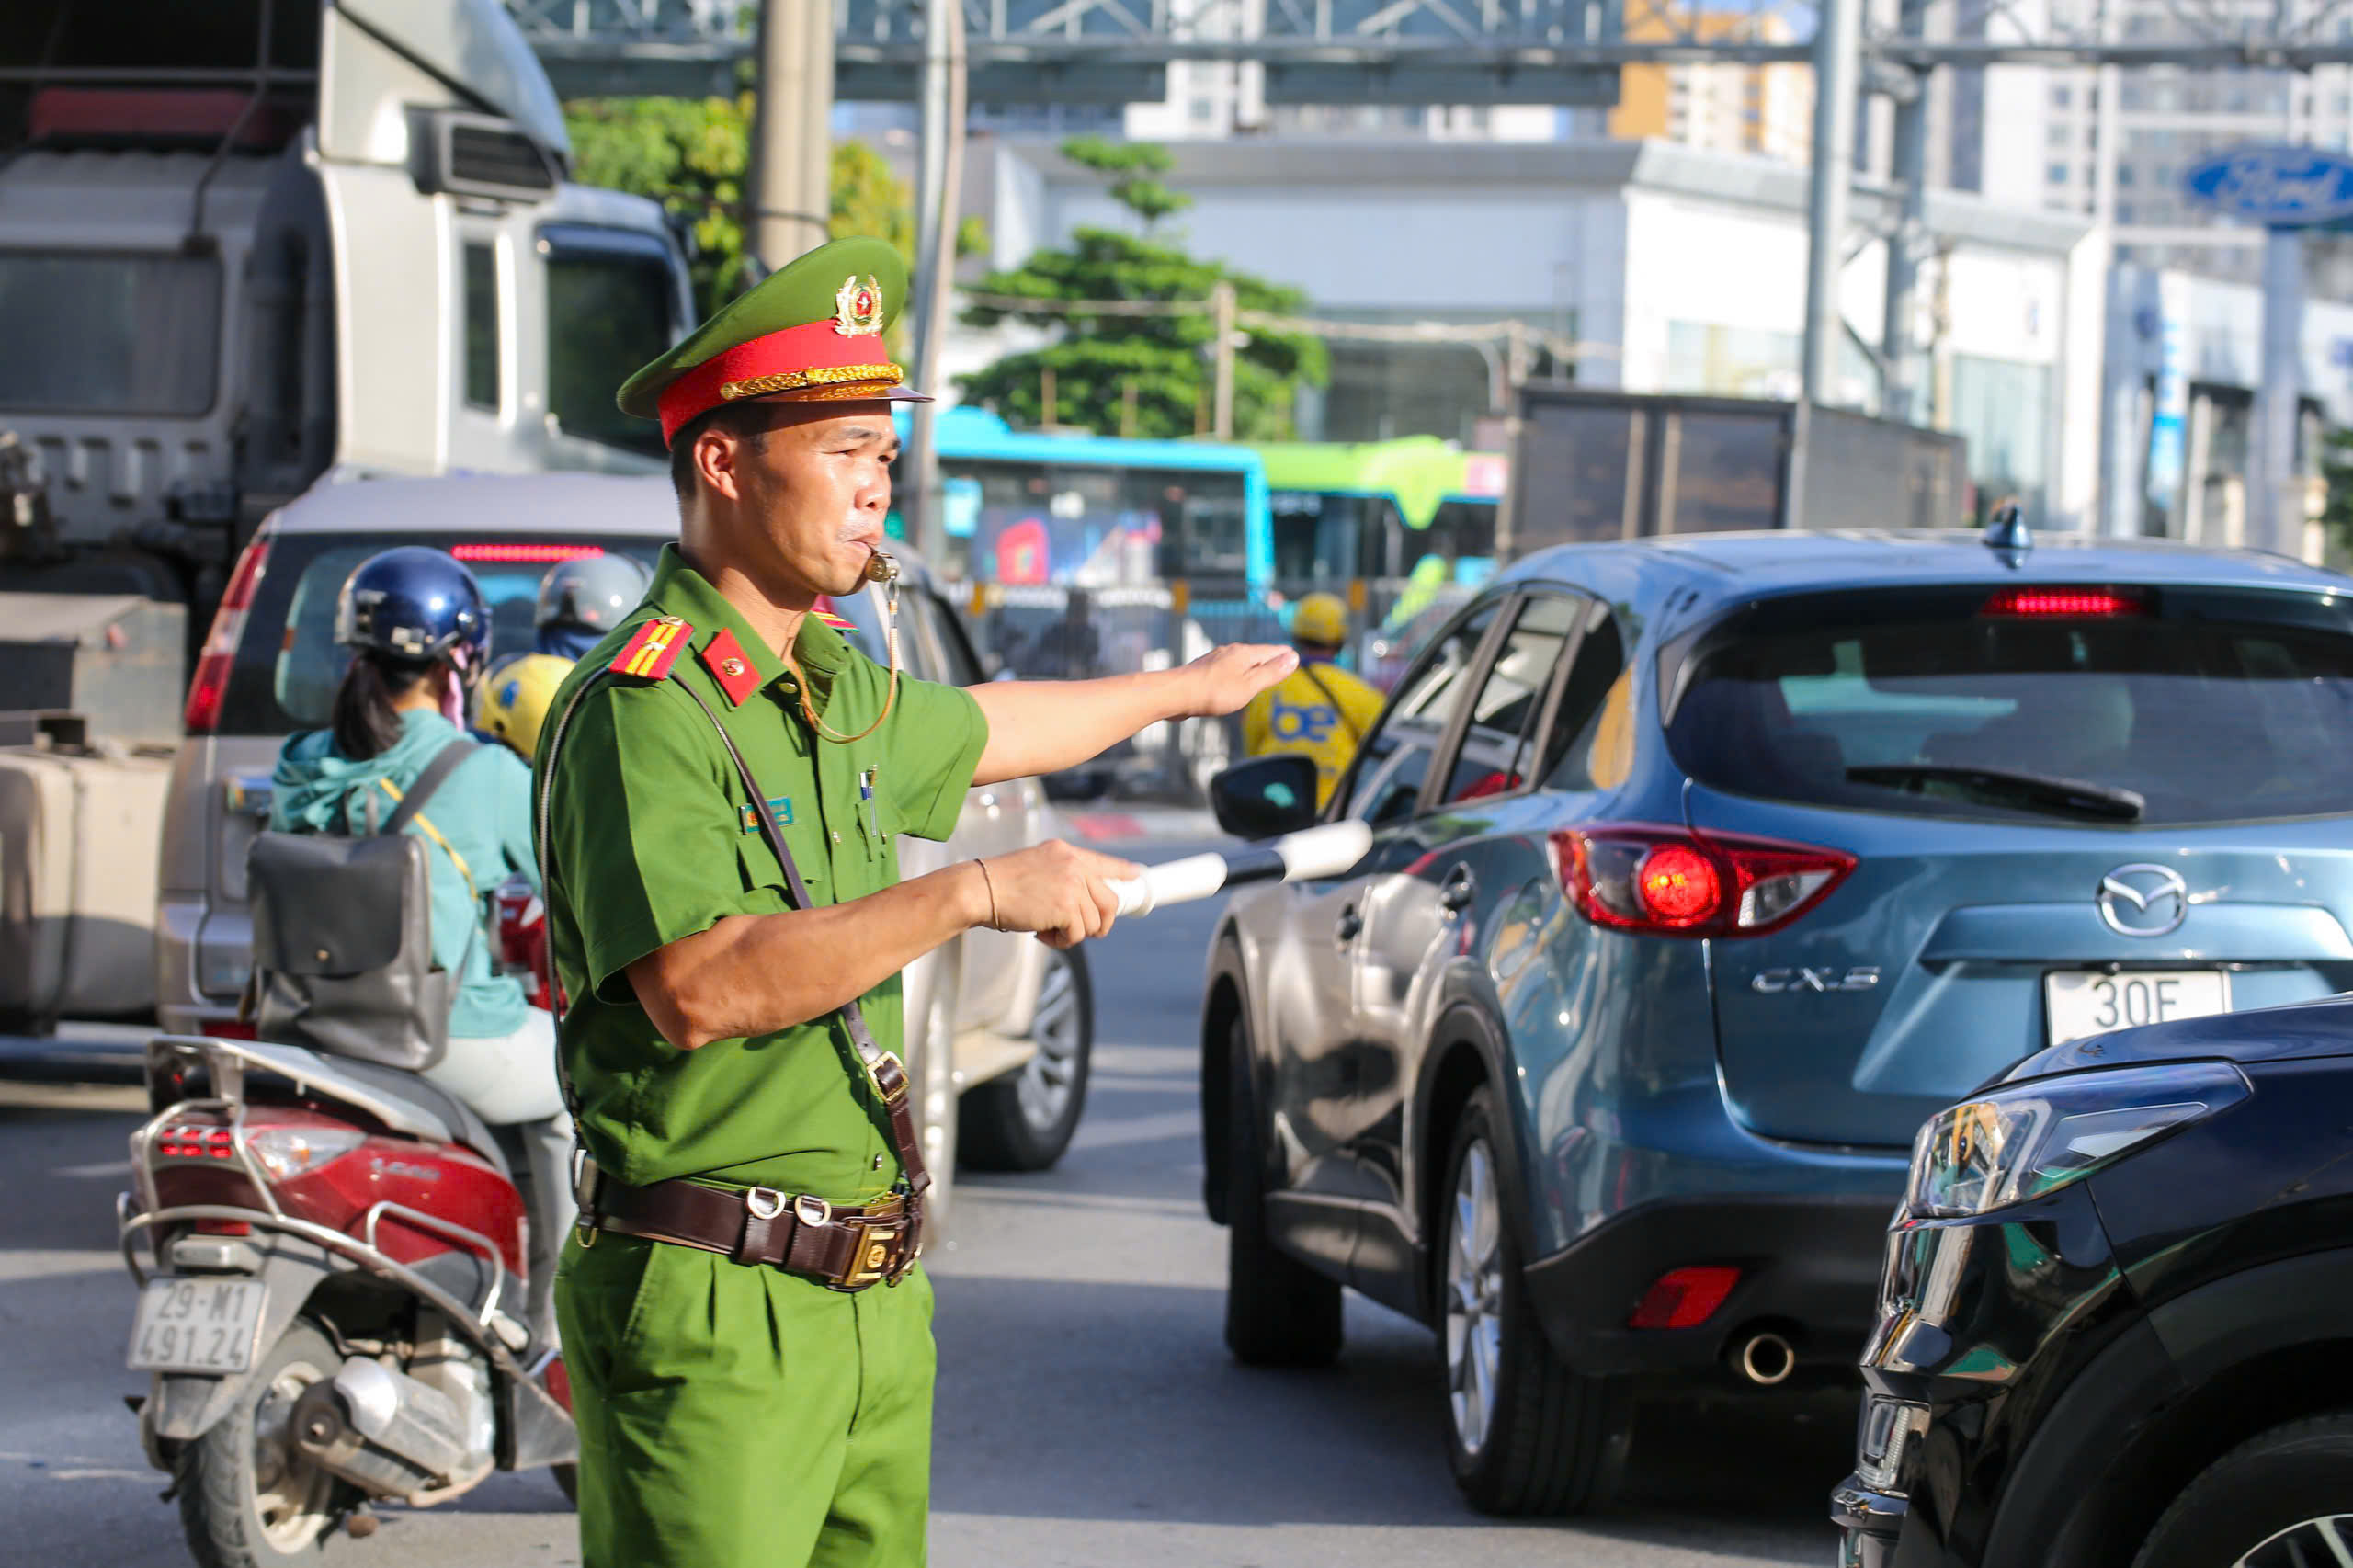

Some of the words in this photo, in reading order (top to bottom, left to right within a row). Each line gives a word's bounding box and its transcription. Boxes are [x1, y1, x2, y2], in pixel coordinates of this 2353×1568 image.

[1272, 693, 1336, 742] be
[158, 1281, 245, 1322] 29-M1
[140, 1325, 243, 1367] 491.24
